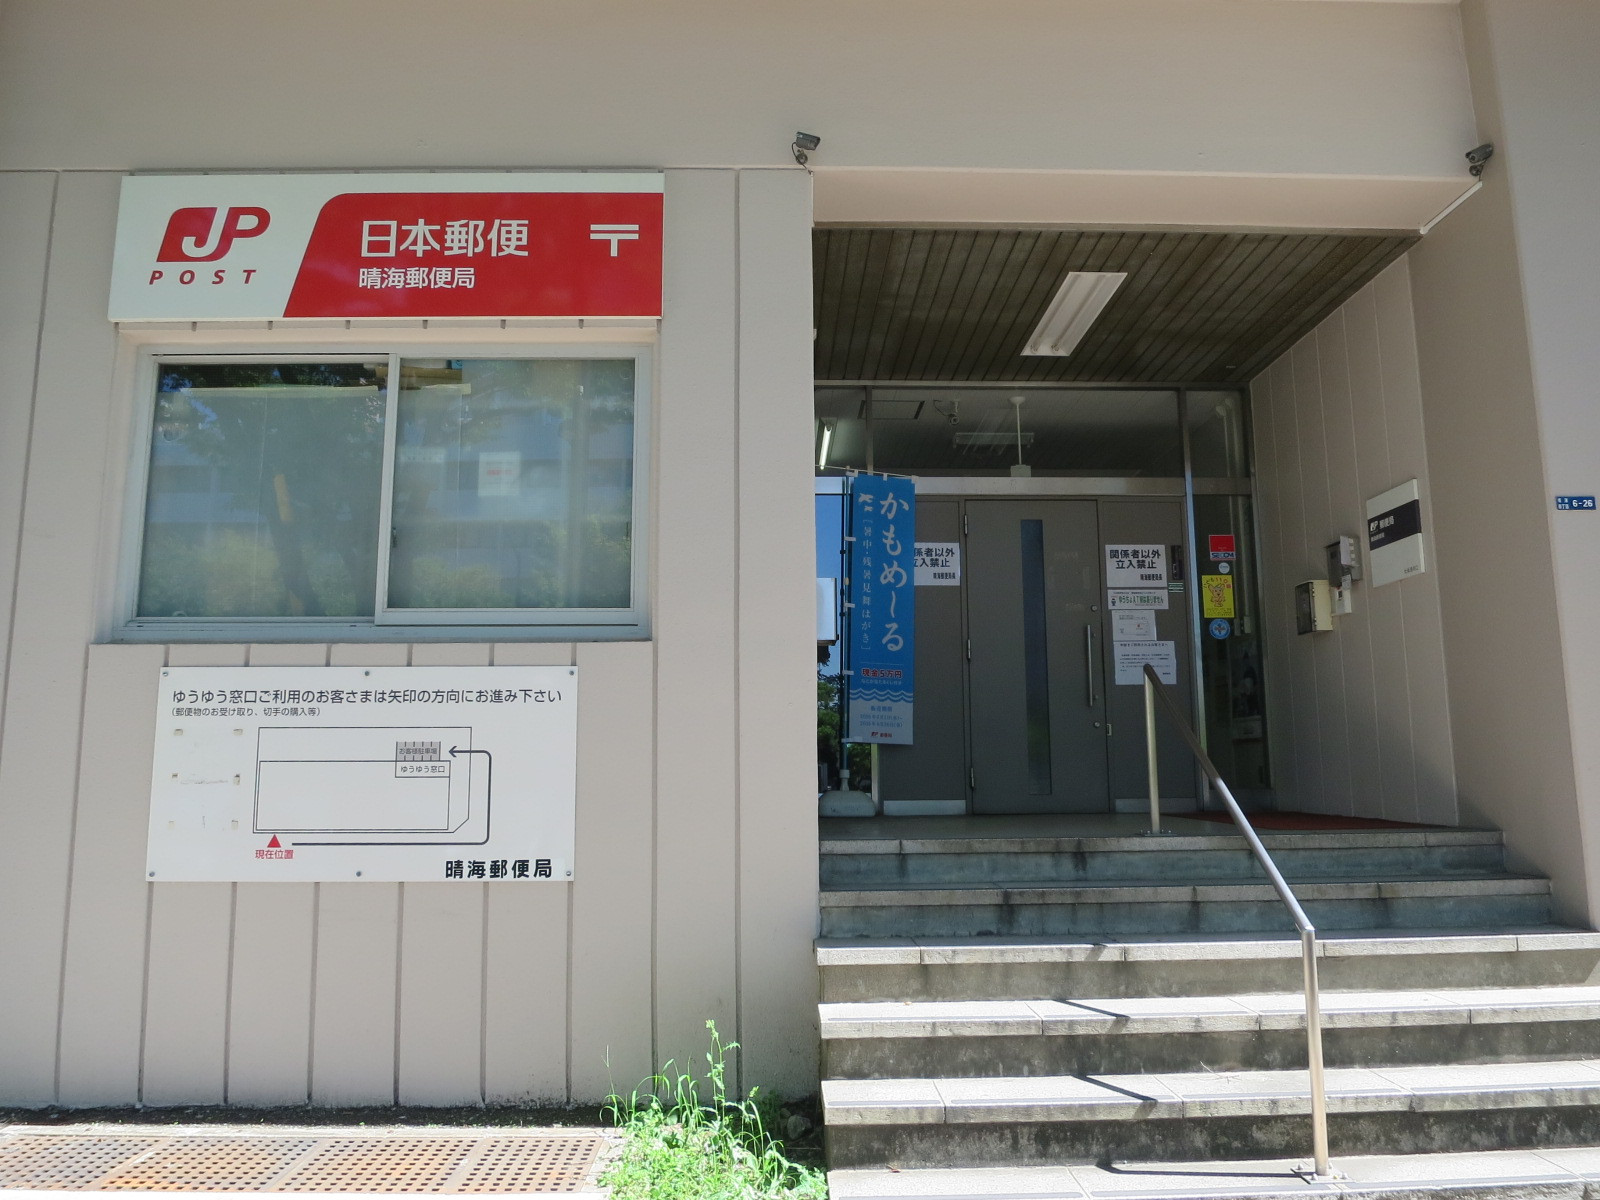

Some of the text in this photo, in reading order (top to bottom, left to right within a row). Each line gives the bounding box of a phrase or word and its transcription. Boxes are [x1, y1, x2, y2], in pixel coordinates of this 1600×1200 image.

[157, 206, 271, 262] JP
[361, 218, 529, 258] 日本郵便
[149, 269, 258, 285] POST
[358, 267, 476, 289] 晴海郵便局
[1572, 499, 1594, 508] 6-26
[914, 547, 955, 558] 係者以外
[1109, 549, 1161, 559] 関係者以外
[1115, 559, 1157, 570] 立入禁止
[861, 668, 903, 679] 現金5万円
[172, 688, 562, 705] ゆうゆう窓口ご利用のお客さまは矢印の方向にお進み下さい
[400, 765, 446, 773] ゆうゆう窓口
[255, 849, 294, 860] 現在位置
[444, 858, 552, 879] 晴海郵便局
